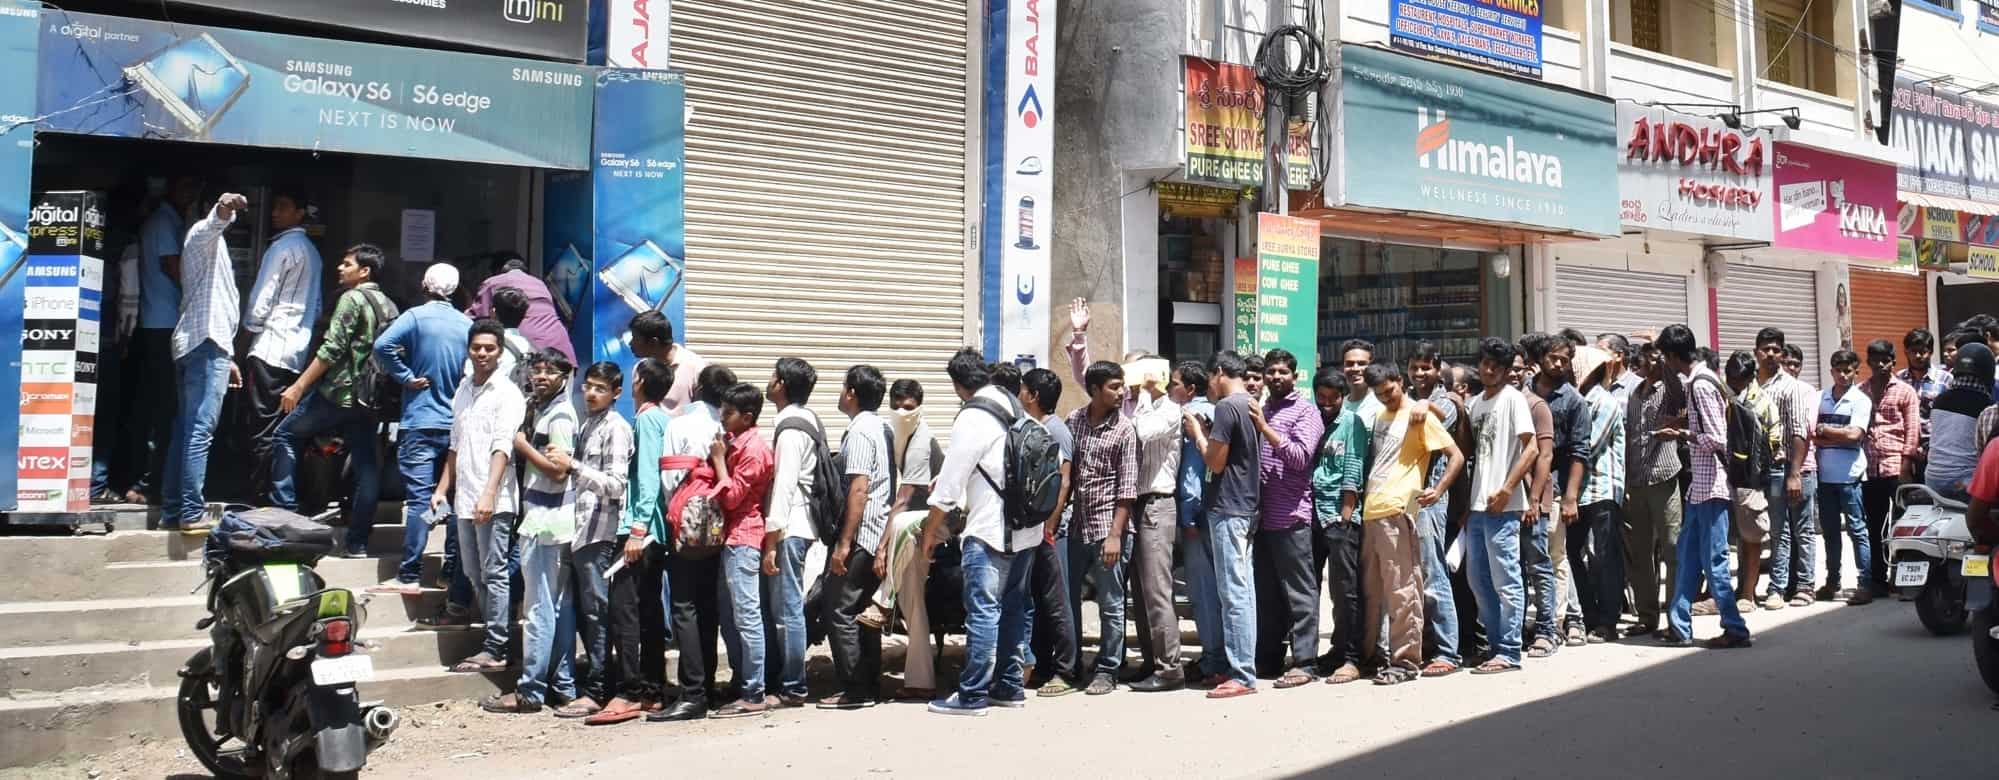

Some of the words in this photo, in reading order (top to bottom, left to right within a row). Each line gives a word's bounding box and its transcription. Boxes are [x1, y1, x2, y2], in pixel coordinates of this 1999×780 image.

[49, 24, 57, 33] A
[61, 21, 102, 39] digital
[104, 31, 140, 42] partner
[632, 0, 650, 68] AJA
[1025, 0, 1039, 76] BAJA
[286, 60, 353, 77] SAMSUNG
[511, 67, 583, 88] SAMSUNG
[284, 74, 364, 102] Galaxy
[366, 80, 392, 101] S6
[412, 84, 438, 106] S6
[441, 89, 491, 111] edge
[318, 108, 372, 129] NEXT
[380, 113, 398, 129] IS
[406, 116, 456, 134] NOW
[1190, 122, 1220, 148] SREE
[1288, 134, 1309, 158] RES
[1416, 106, 1563, 188] Himalaya
[1627, 117, 1764, 178] ANDHRA
[1888, 114, 1968, 177] ANAKA
[1971, 131, 1999, 185] SA
[1190, 157, 1219, 178] PURE
[1222, 160, 1250, 180] GHEE
[1288, 166, 1310, 186] ERE
[1420, 183, 1488, 205] WELLNESS
[1495, 194, 1531, 211] SINCE
[1839, 201, 1888, 235] KAIRA
[27, 226, 78, 238] xpress
[27, 266, 77, 277] AMSUNG
[1262, 258, 1281, 272] PURE
[1282, 261, 1299, 274] GHEE
[1970, 253, 1996, 272] SCHOOL
[1262, 276, 1277, 289] COW
[1280, 279, 1299, 291] GHEE
[1261, 294, 1288, 308] BUTTER
[22, 329, 73, 340] SONY
